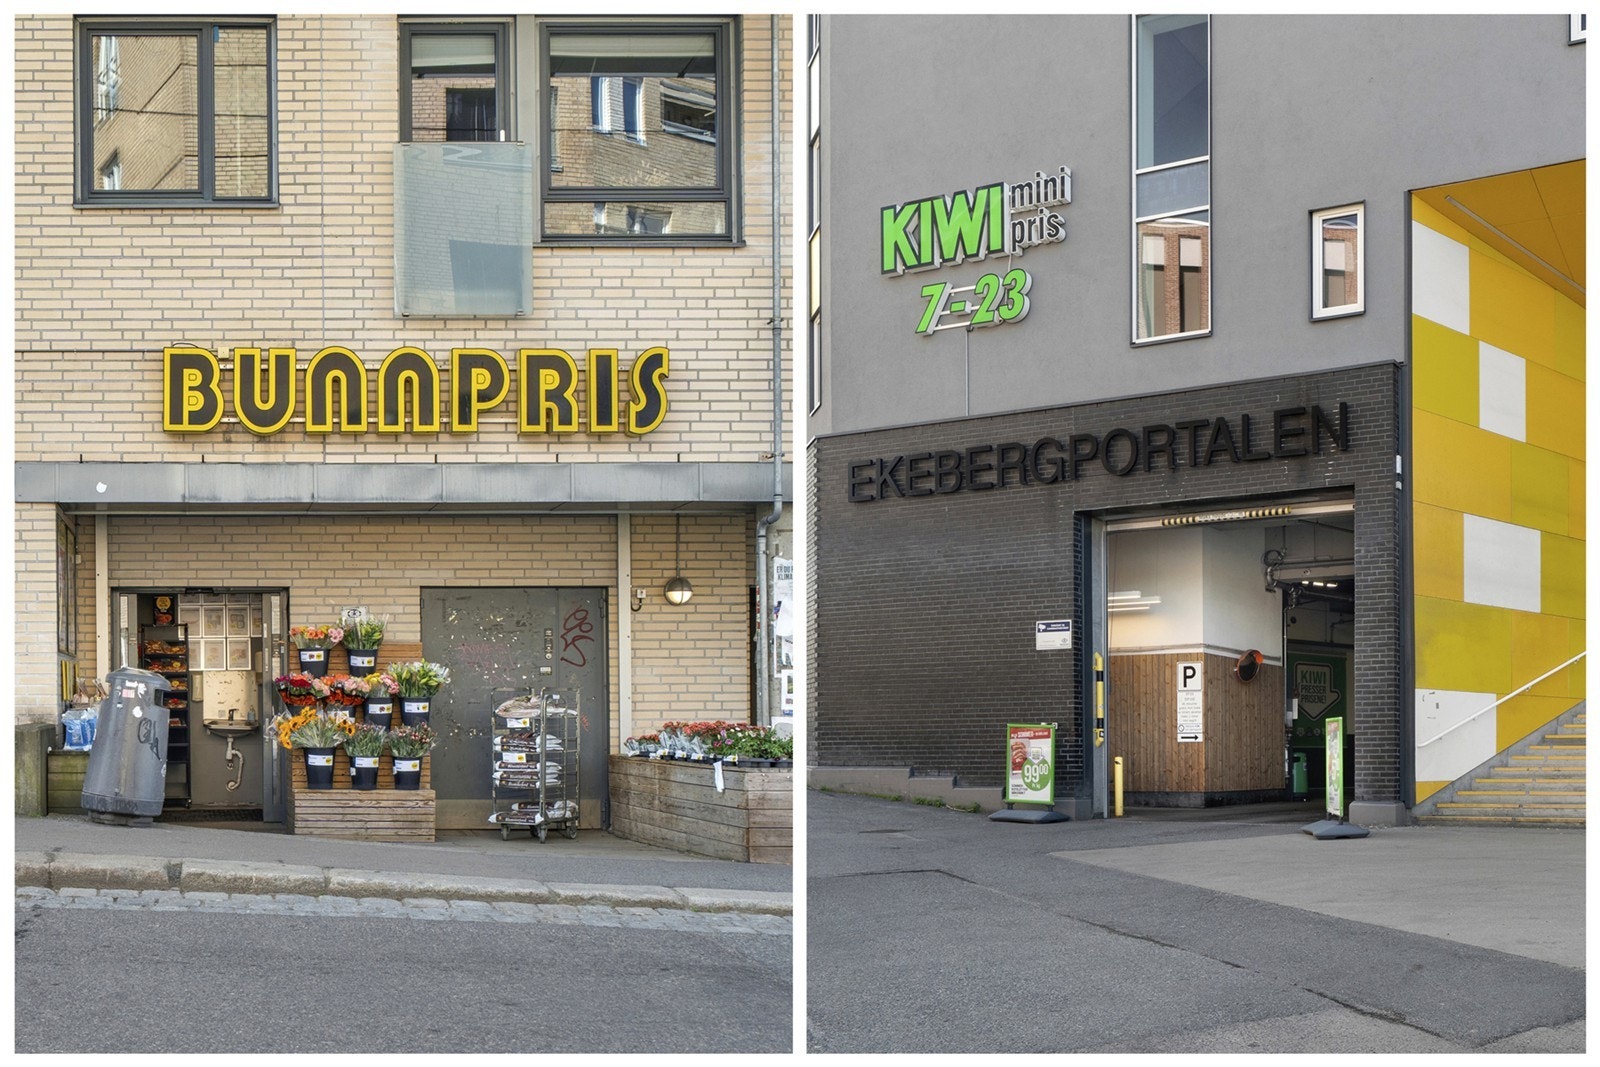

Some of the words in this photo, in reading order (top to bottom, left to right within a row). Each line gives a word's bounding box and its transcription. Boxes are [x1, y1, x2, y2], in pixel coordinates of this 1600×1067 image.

[1011, 165, 1068, 210] mini
[881, 182, 1008, 275] KIWI
[1011, 207, 1064, 255] pris
[163, 346, 669, 435] BUNNPRIS
[848, 402, 1348, 502] EKEBERGPORTALEN
[1183, 666, 1196, 688] P
[1300, 670, 1326, 684] KIWI
[1300, 684, 1327, 694] PRESSER
